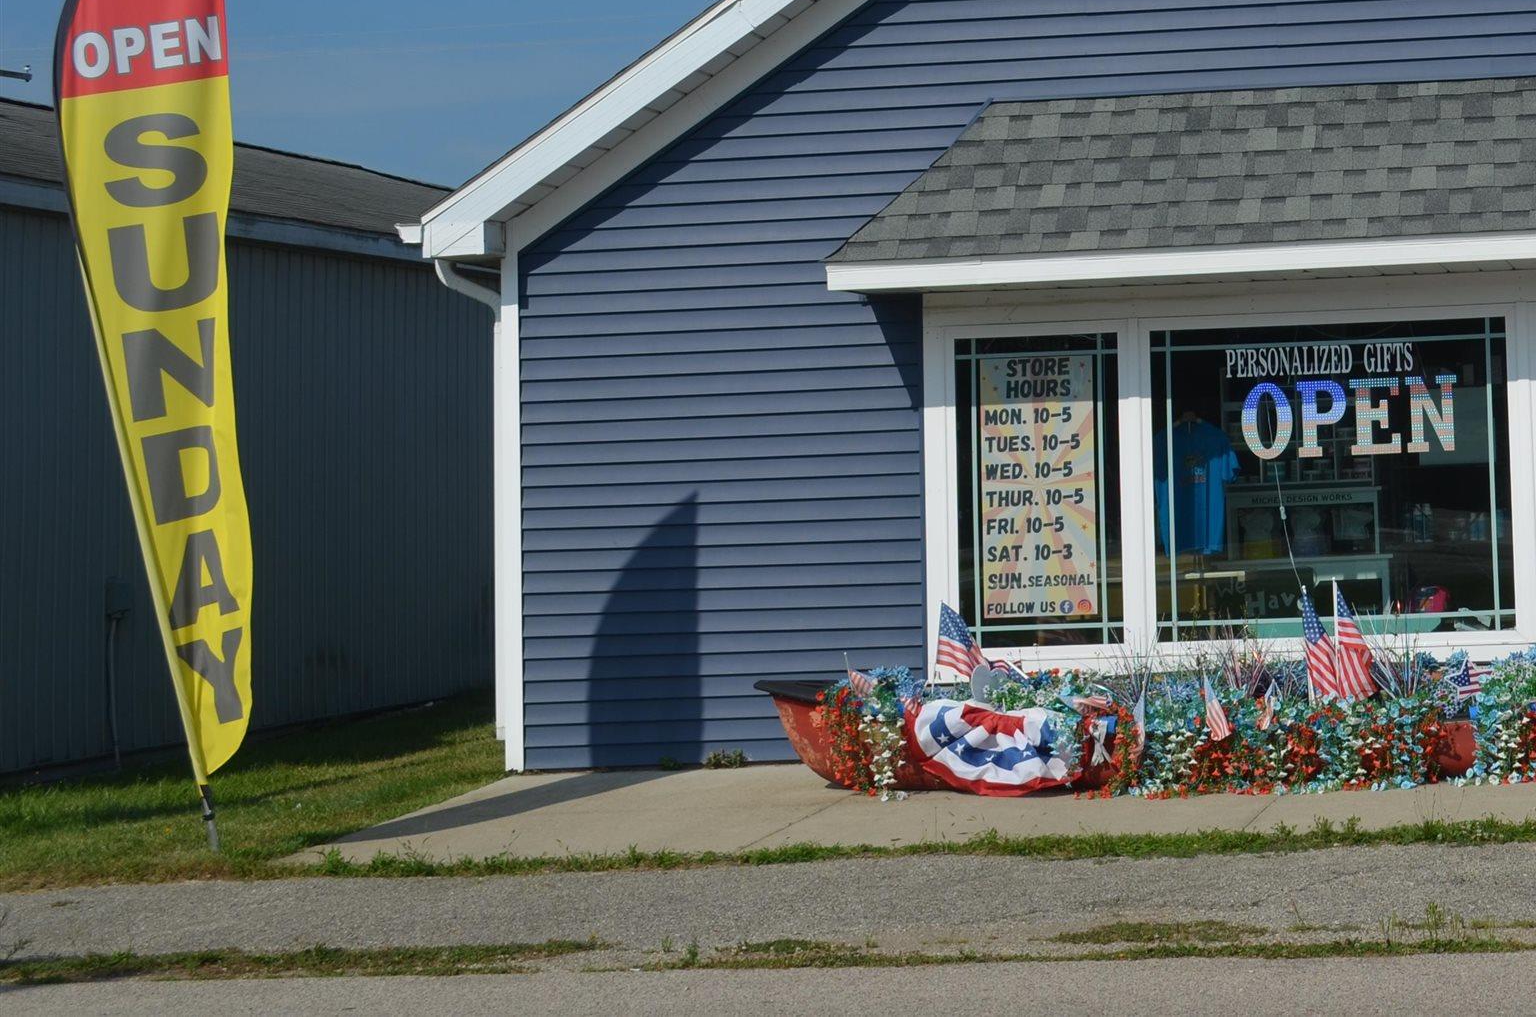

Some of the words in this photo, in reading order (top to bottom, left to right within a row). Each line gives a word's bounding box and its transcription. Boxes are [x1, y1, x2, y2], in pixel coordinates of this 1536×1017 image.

[73, 14, 222, 81] OPEN
[1006, 357, 1070, 378] STORE
[1225, 343, 1353, 378] PERSONALIZED
[1363, 342, 1414, 374] GIFTS
[1005, 378, 1071, 399] HOURS
[103, 112, 244, 726] SUNDAY
[984, 408, 1027, 426] MON.
[1033, 406, 1073, 425] 10-5
[1240, 374, 1457, 460] OPEN
[985, 435, 1036, 453] TUES.
[1042, 434, 1081, 452] 10-5
[985, 462, 1028, 480] WED.
[1034, 460, 1074, 479] 10-5
[986, 489, 1040, 508] THUR.
[1045, 488, 1085, 506] 10-5
[1286, 494, 1319, 503] DESIGN
[1321, 492, 1353, 502] WORKS
[986, 518, 1020, 535] FRI.
[1026, 516, 1065, 534] 10-5
[987, 545, 1028, 562] SAT.
[1034, 543, 1073, 560] 10-3
[1028, 573, 1095, 588] SEASONAL
[987, 601, 1035, 615] FOLLOW
[1039, 600, 1057, 614] US
